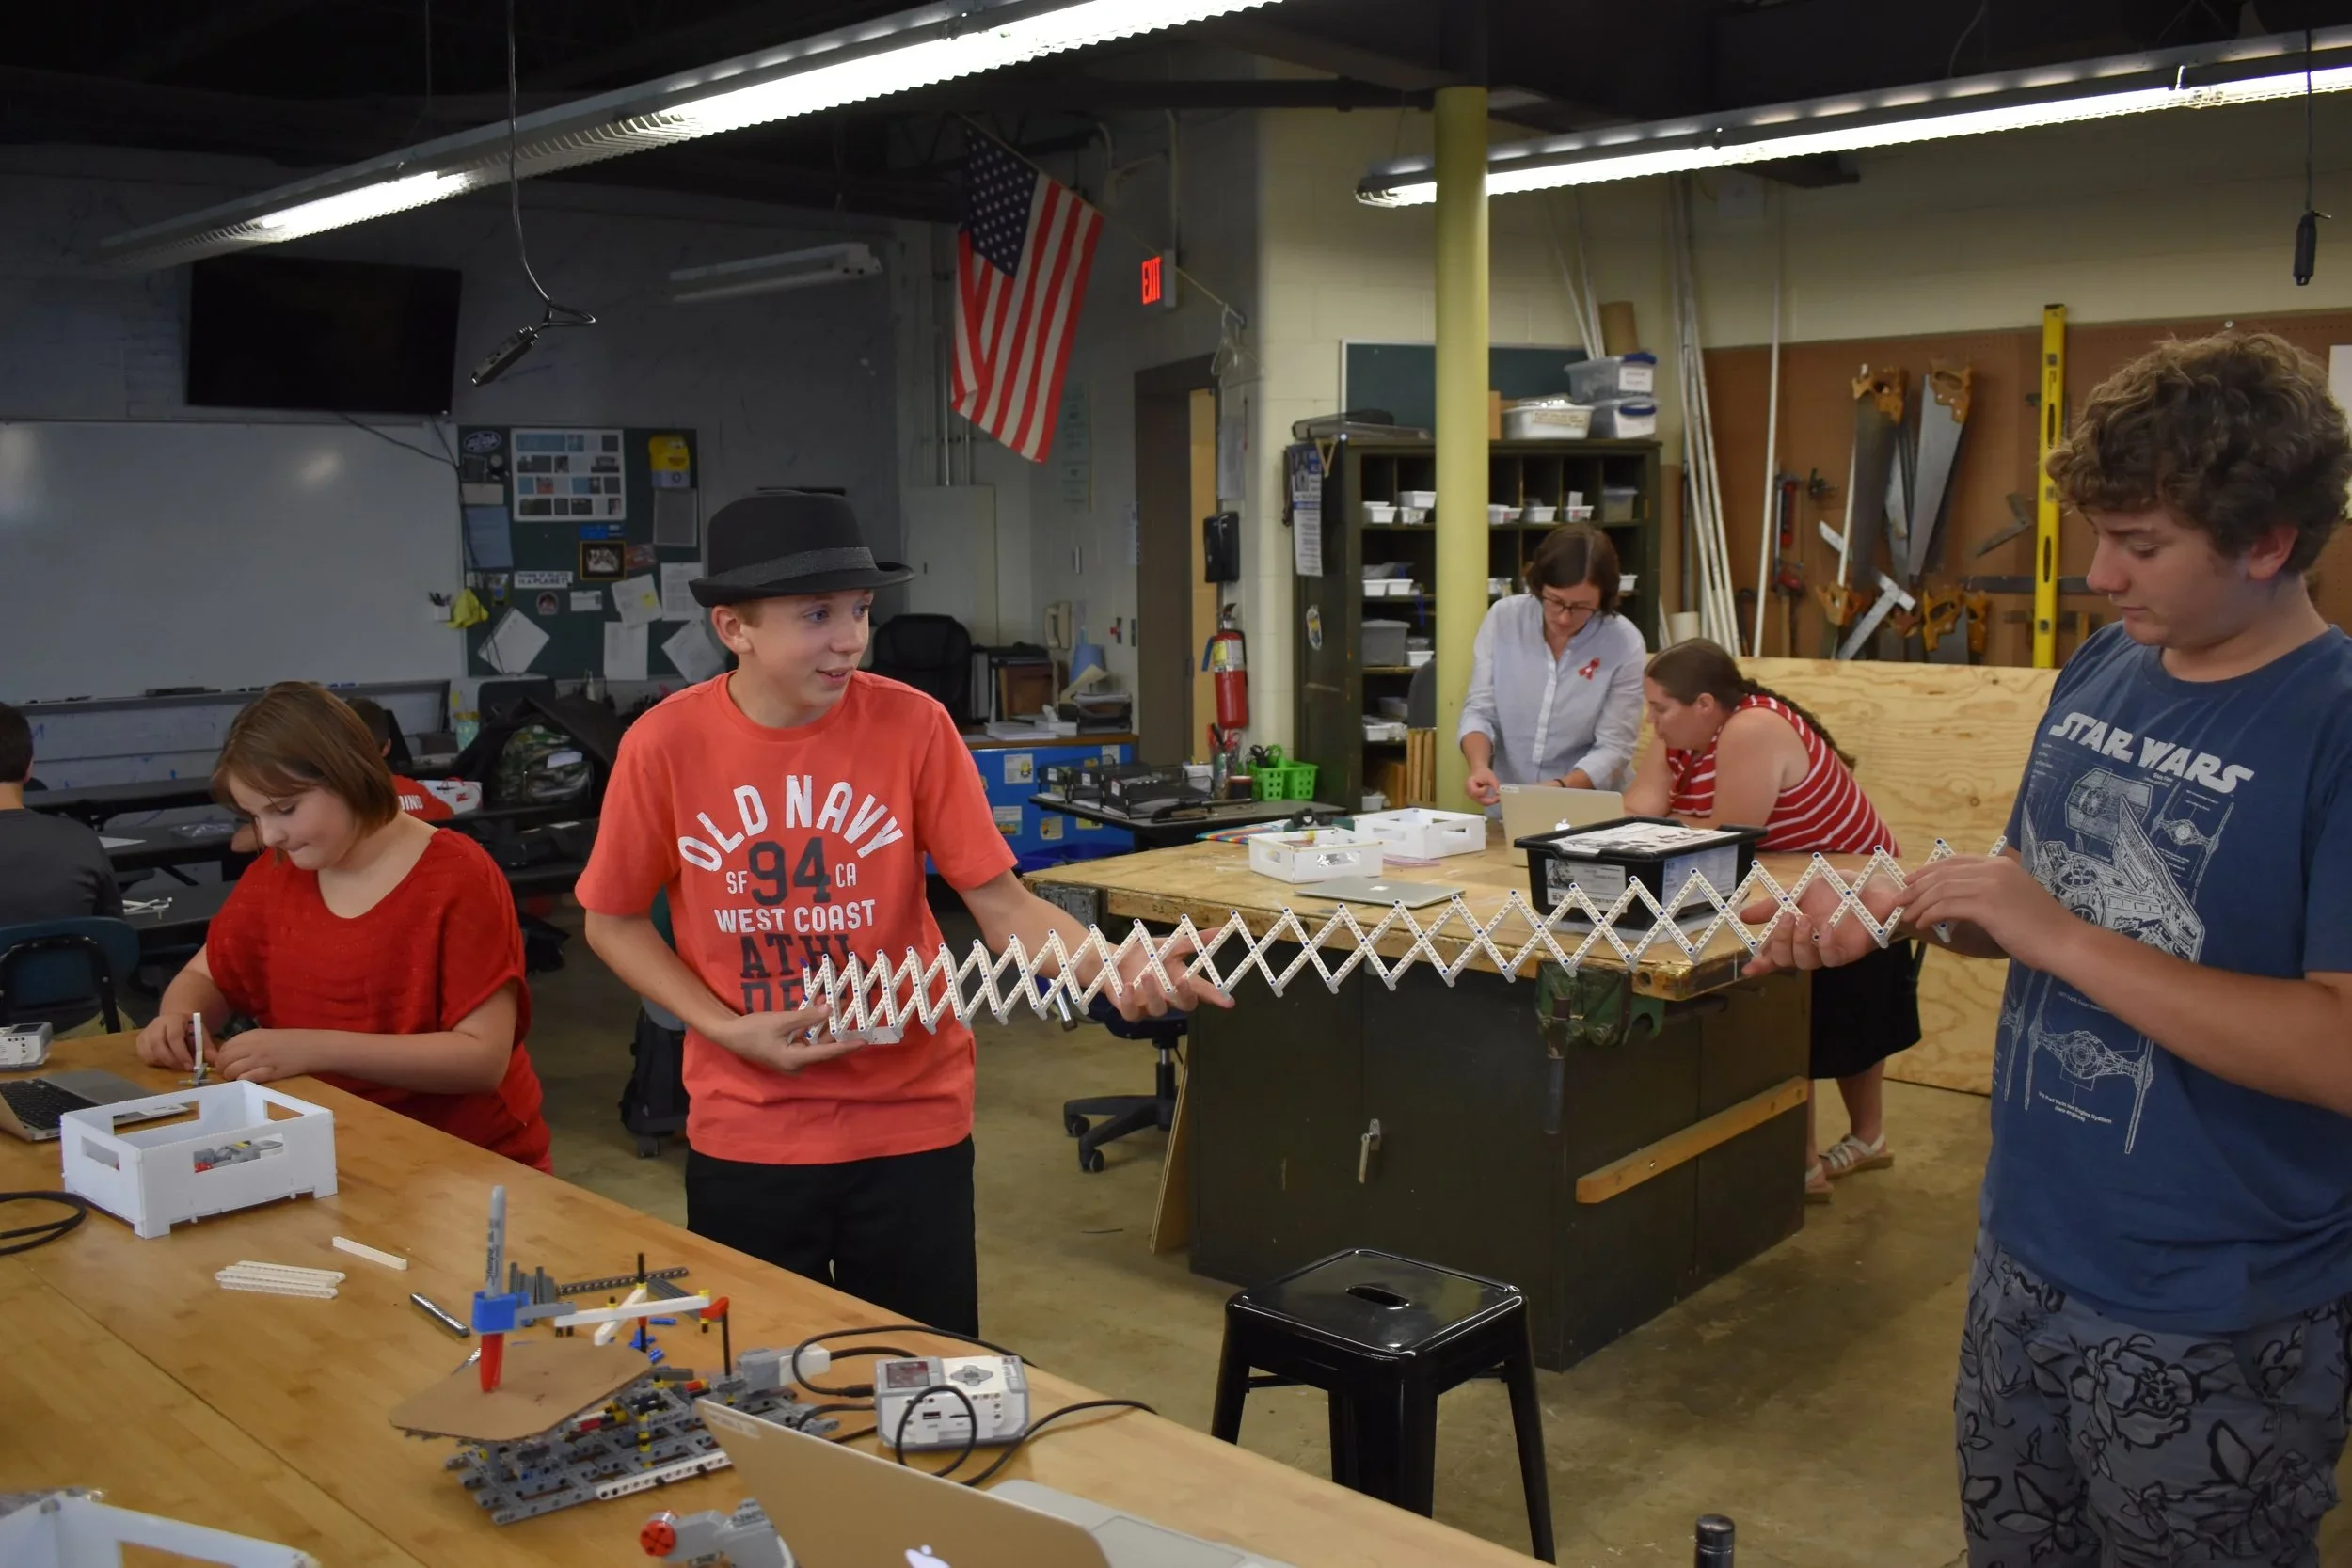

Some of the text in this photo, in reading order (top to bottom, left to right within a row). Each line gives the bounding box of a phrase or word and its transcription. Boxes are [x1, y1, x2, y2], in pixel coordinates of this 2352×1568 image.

[1141, 255, 1161, 305] EXIT
[2048, 711, 2134, 763] STAR
[2137, 736, 2255, 794] WARS
[677, 774, 904, 872] OLD NAVY
[725, 836, 857, 907] SF 94 CA
[714, 899, 876, 933] WEST COAST
